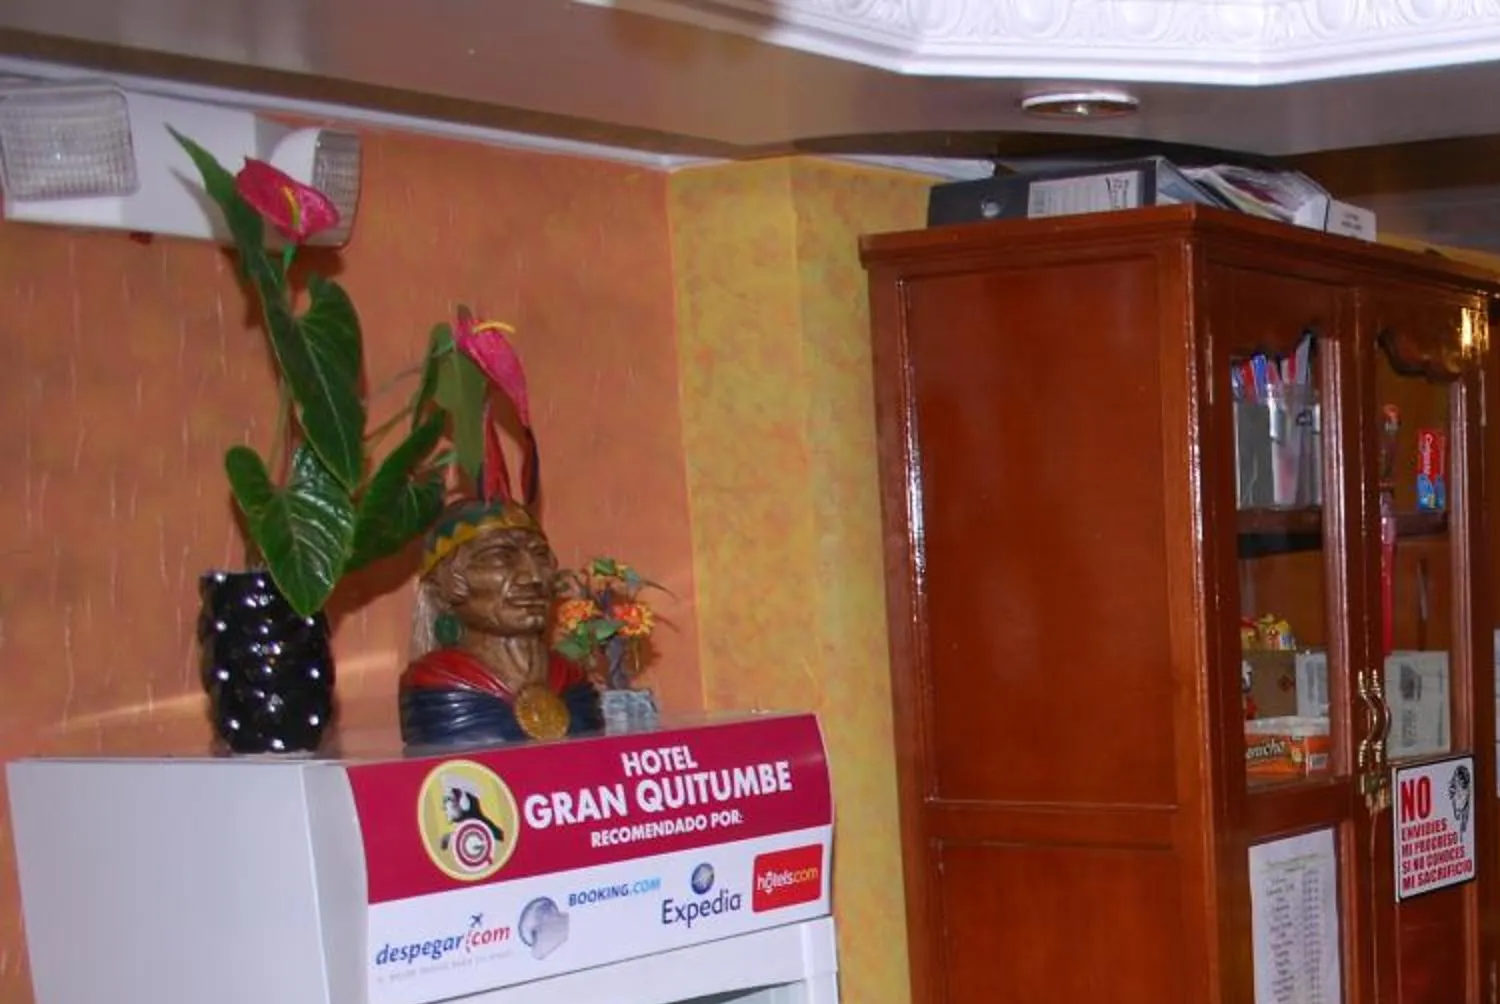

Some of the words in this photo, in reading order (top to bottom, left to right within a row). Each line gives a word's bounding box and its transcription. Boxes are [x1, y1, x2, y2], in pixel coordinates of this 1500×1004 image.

[620, 745, 698, 777] HOTEL
[524, 783, 628, 829] GRAN
[636, 761, 792, 812] QUITUMBE
[1400, 775, 1431, 823] NO
[591, 815, 707, 848] RECOMENDADO
[568, 877, 662, 906] BOOKING.COM
[1403, 875, 1414, 890] MI
[662, 889, 742, 928] Expedia
